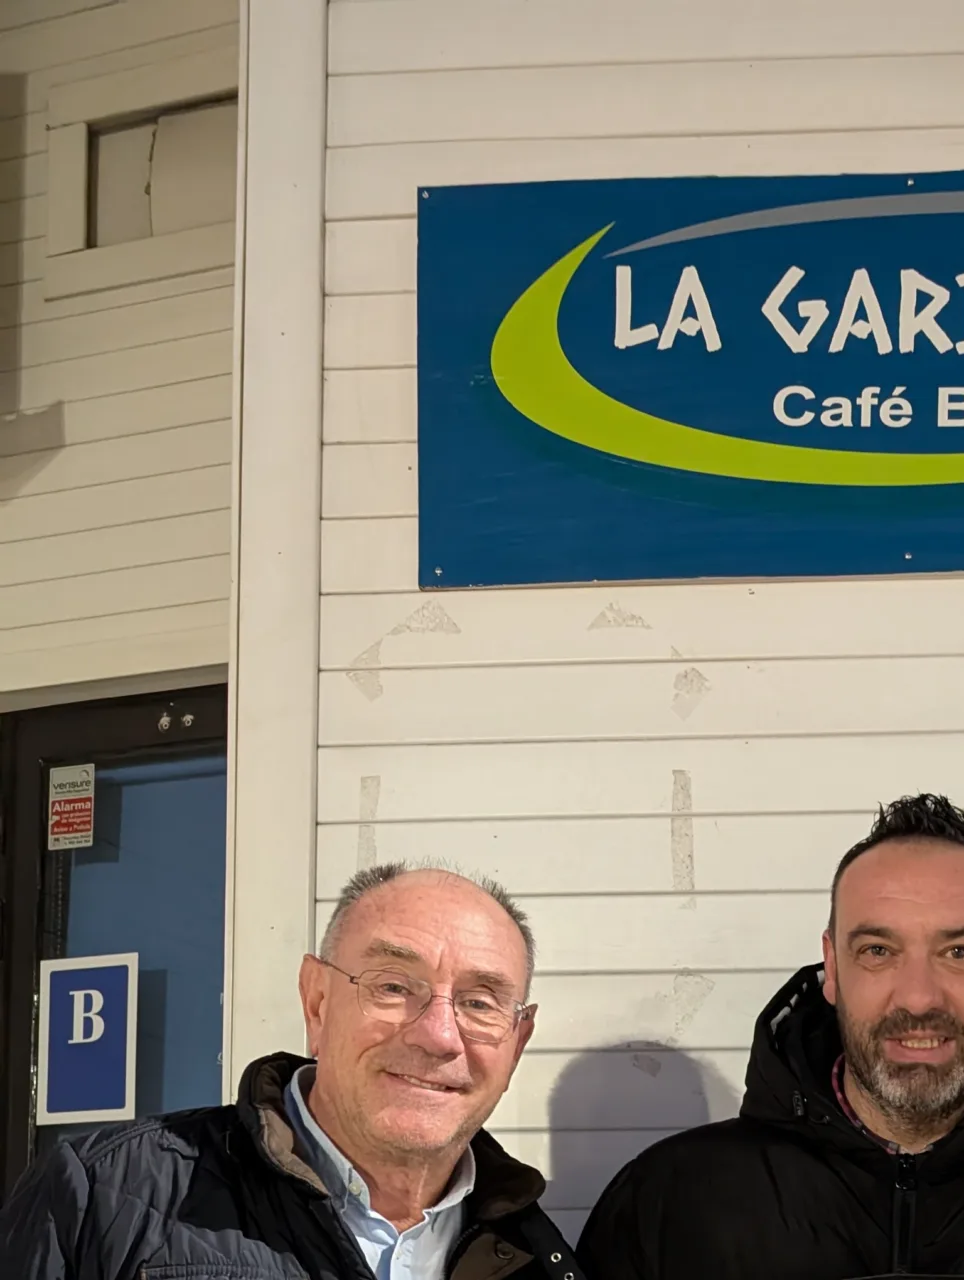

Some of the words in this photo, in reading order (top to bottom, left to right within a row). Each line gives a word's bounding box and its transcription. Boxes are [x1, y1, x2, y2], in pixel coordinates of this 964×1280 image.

[614, 265, 722, 353] LA
[772, 385, 913, 428] Café
[53, 780, 91, 790] verisure
[53, 801, 91, 812] Alarma
[67, 989, 105, 1044] B
